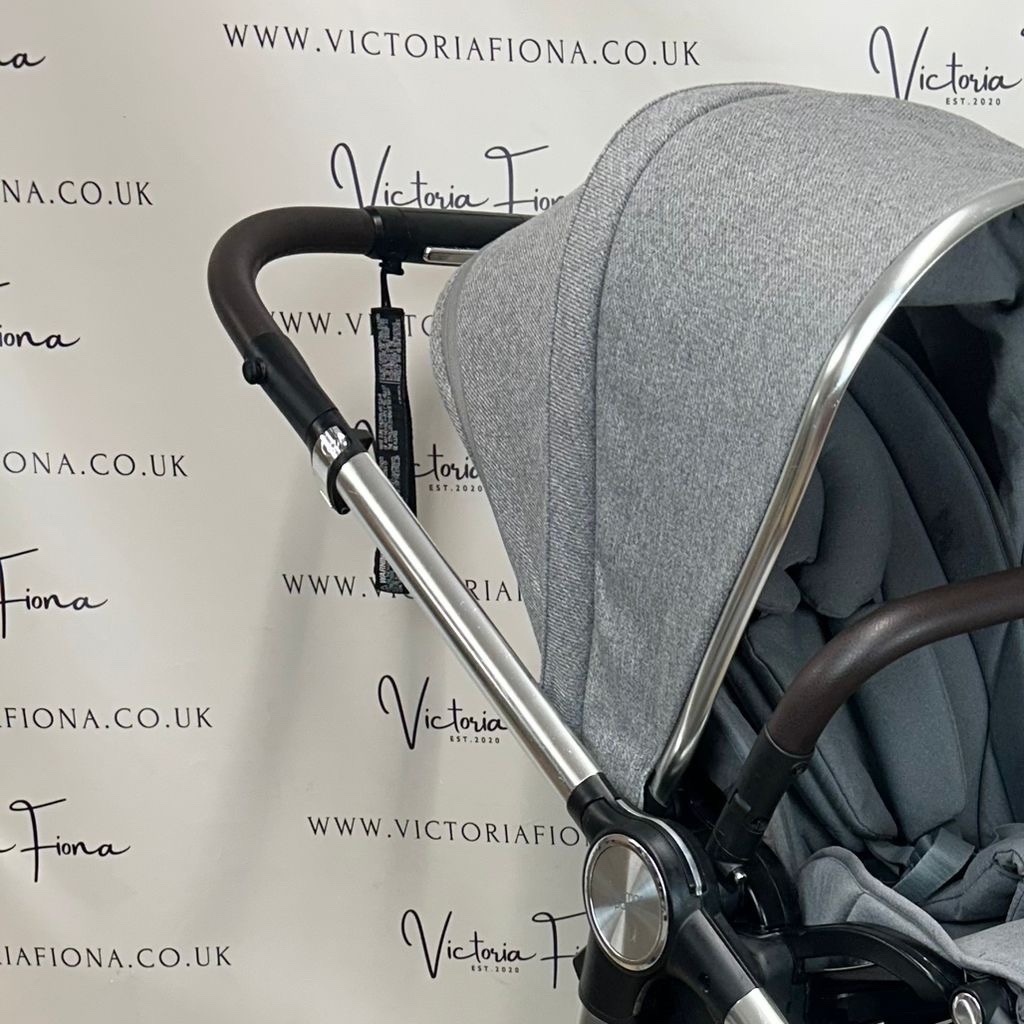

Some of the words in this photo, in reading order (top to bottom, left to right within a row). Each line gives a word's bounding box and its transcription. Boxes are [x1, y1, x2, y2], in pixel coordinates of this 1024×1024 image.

[223, 24, 700, 66] WWW.VICTORIAFIONA.CO.UK
[869, 26, 1023, 100] Victoria
[331, 143, 489, 209] Victoria
[0, 324, 81, 349] iona
[0, 707, 213, 729] FIONA.CO.UK
[378, 674, 509, 750] Victoria
[9, 798, 131, 883] Fiona
[307, 816, 590, 847] WWW.VICTORIAFIO
[0, 946, 231, 968] IAFIONA.CO.UK
[401, 909, 537, 979] Victoria
